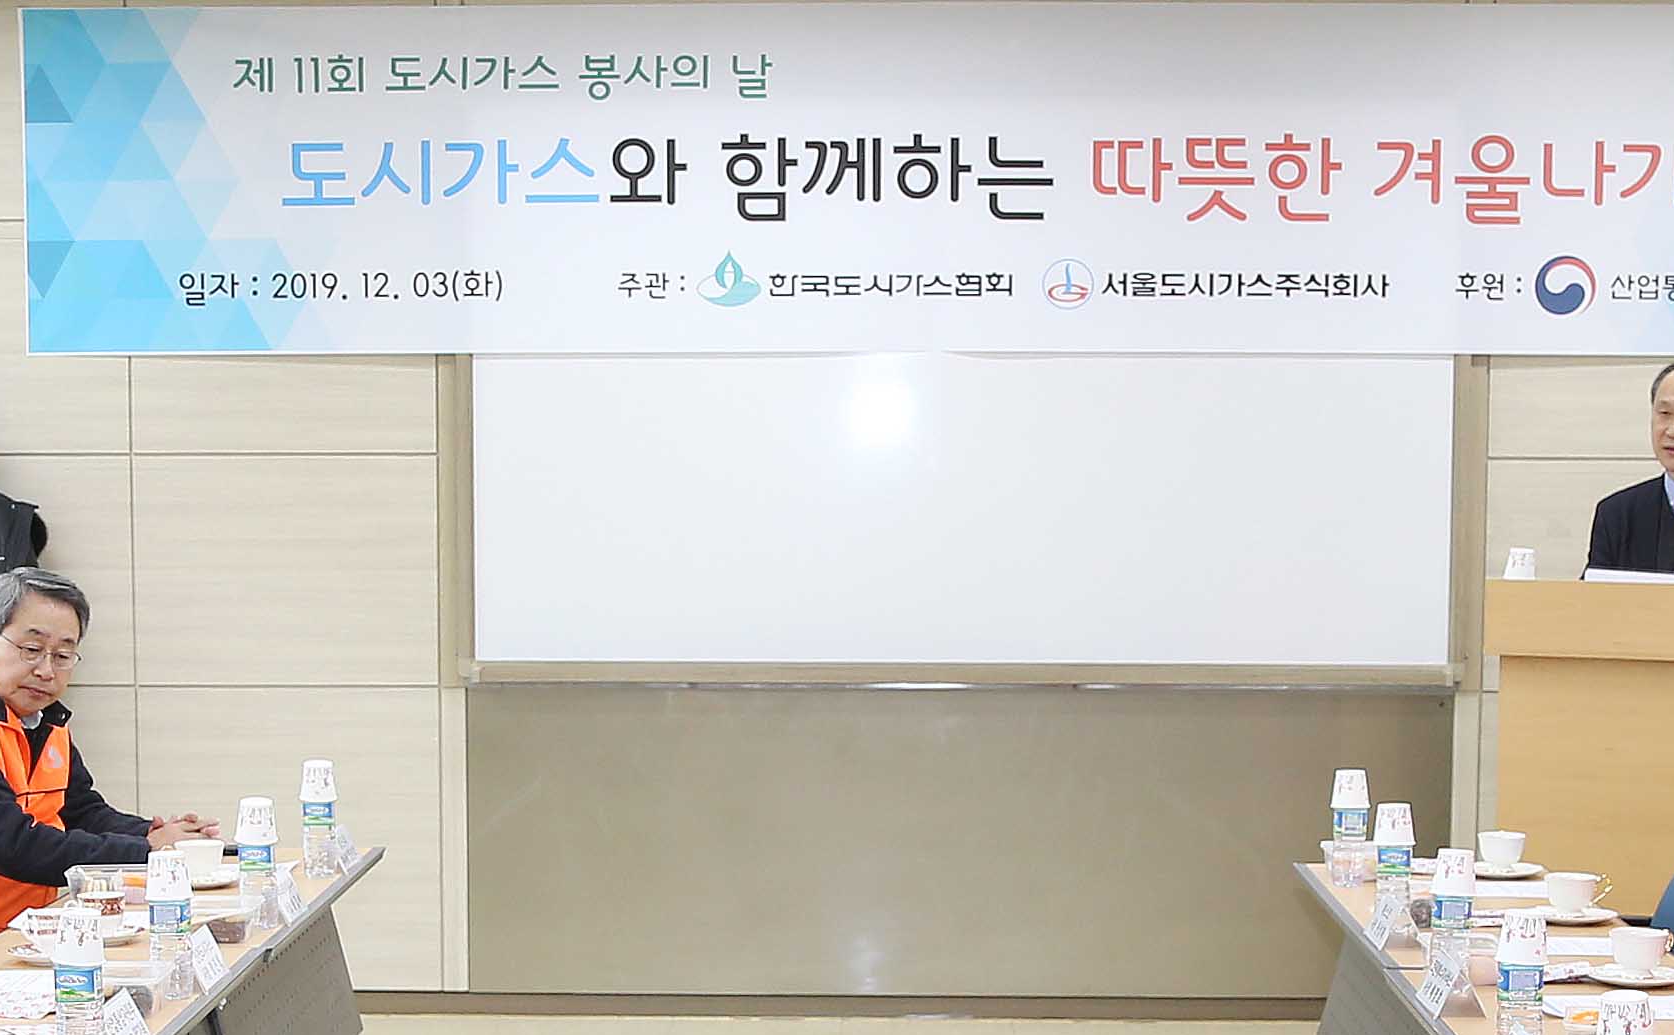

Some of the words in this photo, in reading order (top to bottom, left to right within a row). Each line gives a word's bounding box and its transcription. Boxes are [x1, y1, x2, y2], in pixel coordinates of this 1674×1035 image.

[232, 55, 275, 93] 제
[293, 53, 367, 94] 11회
[385, 55, 560, 92] 도시가스
[578, 54, 711, 101] 봉사의
[732, 53, 773, 99] 날
[282, 136, 688, 208] 도시가스와
[721, 133, 1054, 222] 함께하는
[1092, 133, 1343, 223] 따뜻한
[178, 272, 240, 302] 일자
[271, 271, 348, 301] 2019.
[361, 271, 400, 300] 12.
[412, 269, 503, 303] 03(화)
[617, 272, 670, 300] 주관
[768, 271, 1014, 298] 한국도시가스협회
[1101, 272, 1390, 299] 서울도시가스주식회사
[1455, 272, 1505, 301] 후원
